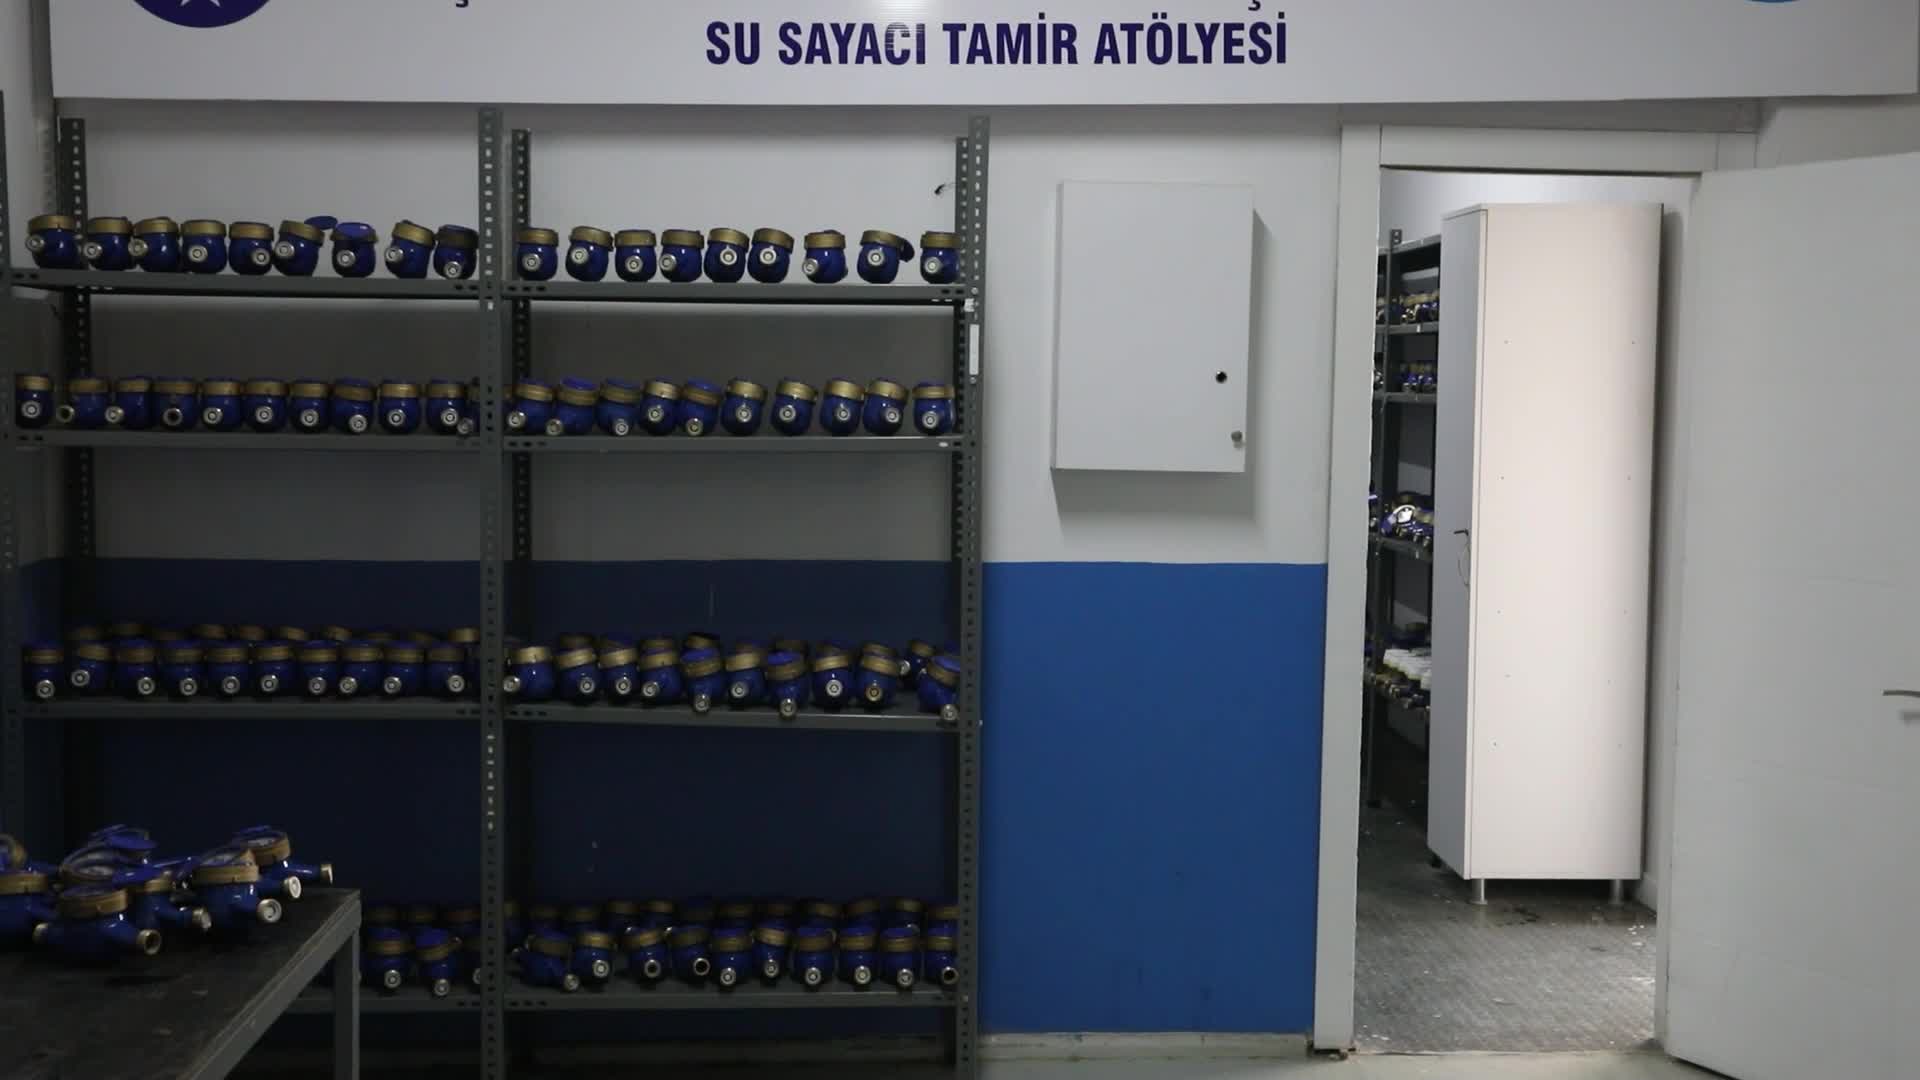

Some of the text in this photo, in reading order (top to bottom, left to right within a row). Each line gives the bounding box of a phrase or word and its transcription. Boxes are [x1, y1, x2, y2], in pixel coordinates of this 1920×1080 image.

[706, 11, 1288, 65] SU SAYACI TAMİR ATÖLYESİ
